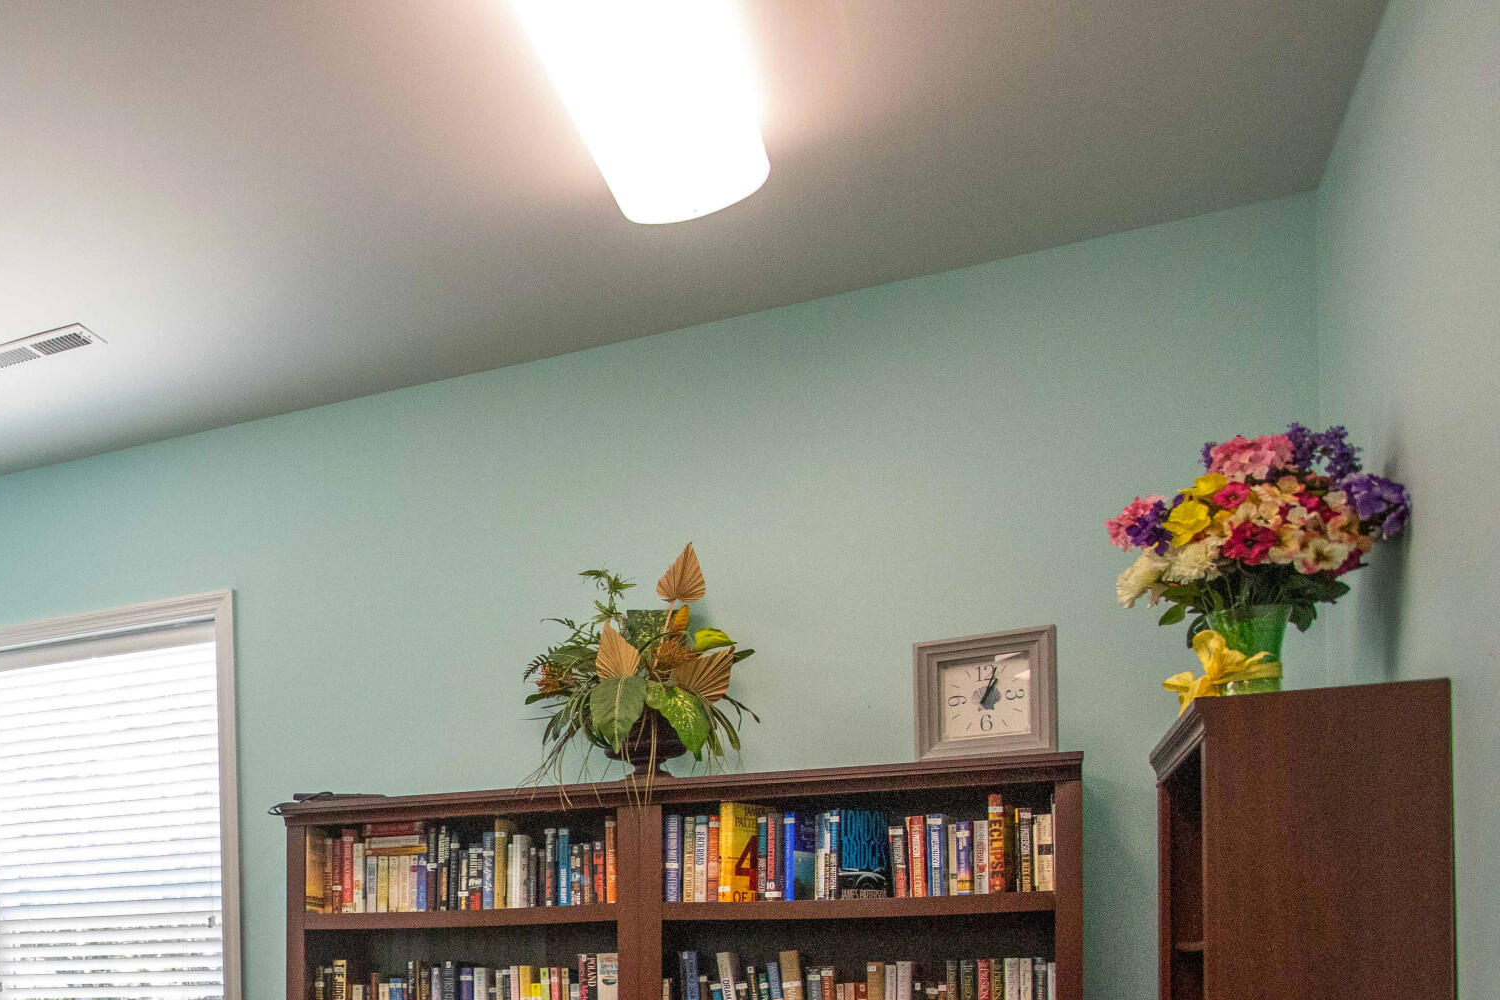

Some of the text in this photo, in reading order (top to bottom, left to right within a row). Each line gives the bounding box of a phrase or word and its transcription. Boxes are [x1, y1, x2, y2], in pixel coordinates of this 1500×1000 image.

[975, 664, 998, 683] 12
[980, 714, 994, 732] 6
[841, 809, 888, 841] LONDON
[695, 849, 705, 865] ROAD
[766, 839, 775, 879] PATTERSON
[989, 819, 1003, 879] ECLIPSE
[734, 835, 758, 891] 4
[766, 881, 775, 890] 10
[334, 964, 344, 978] TE
[586, 956, 597, 987] POLAND
